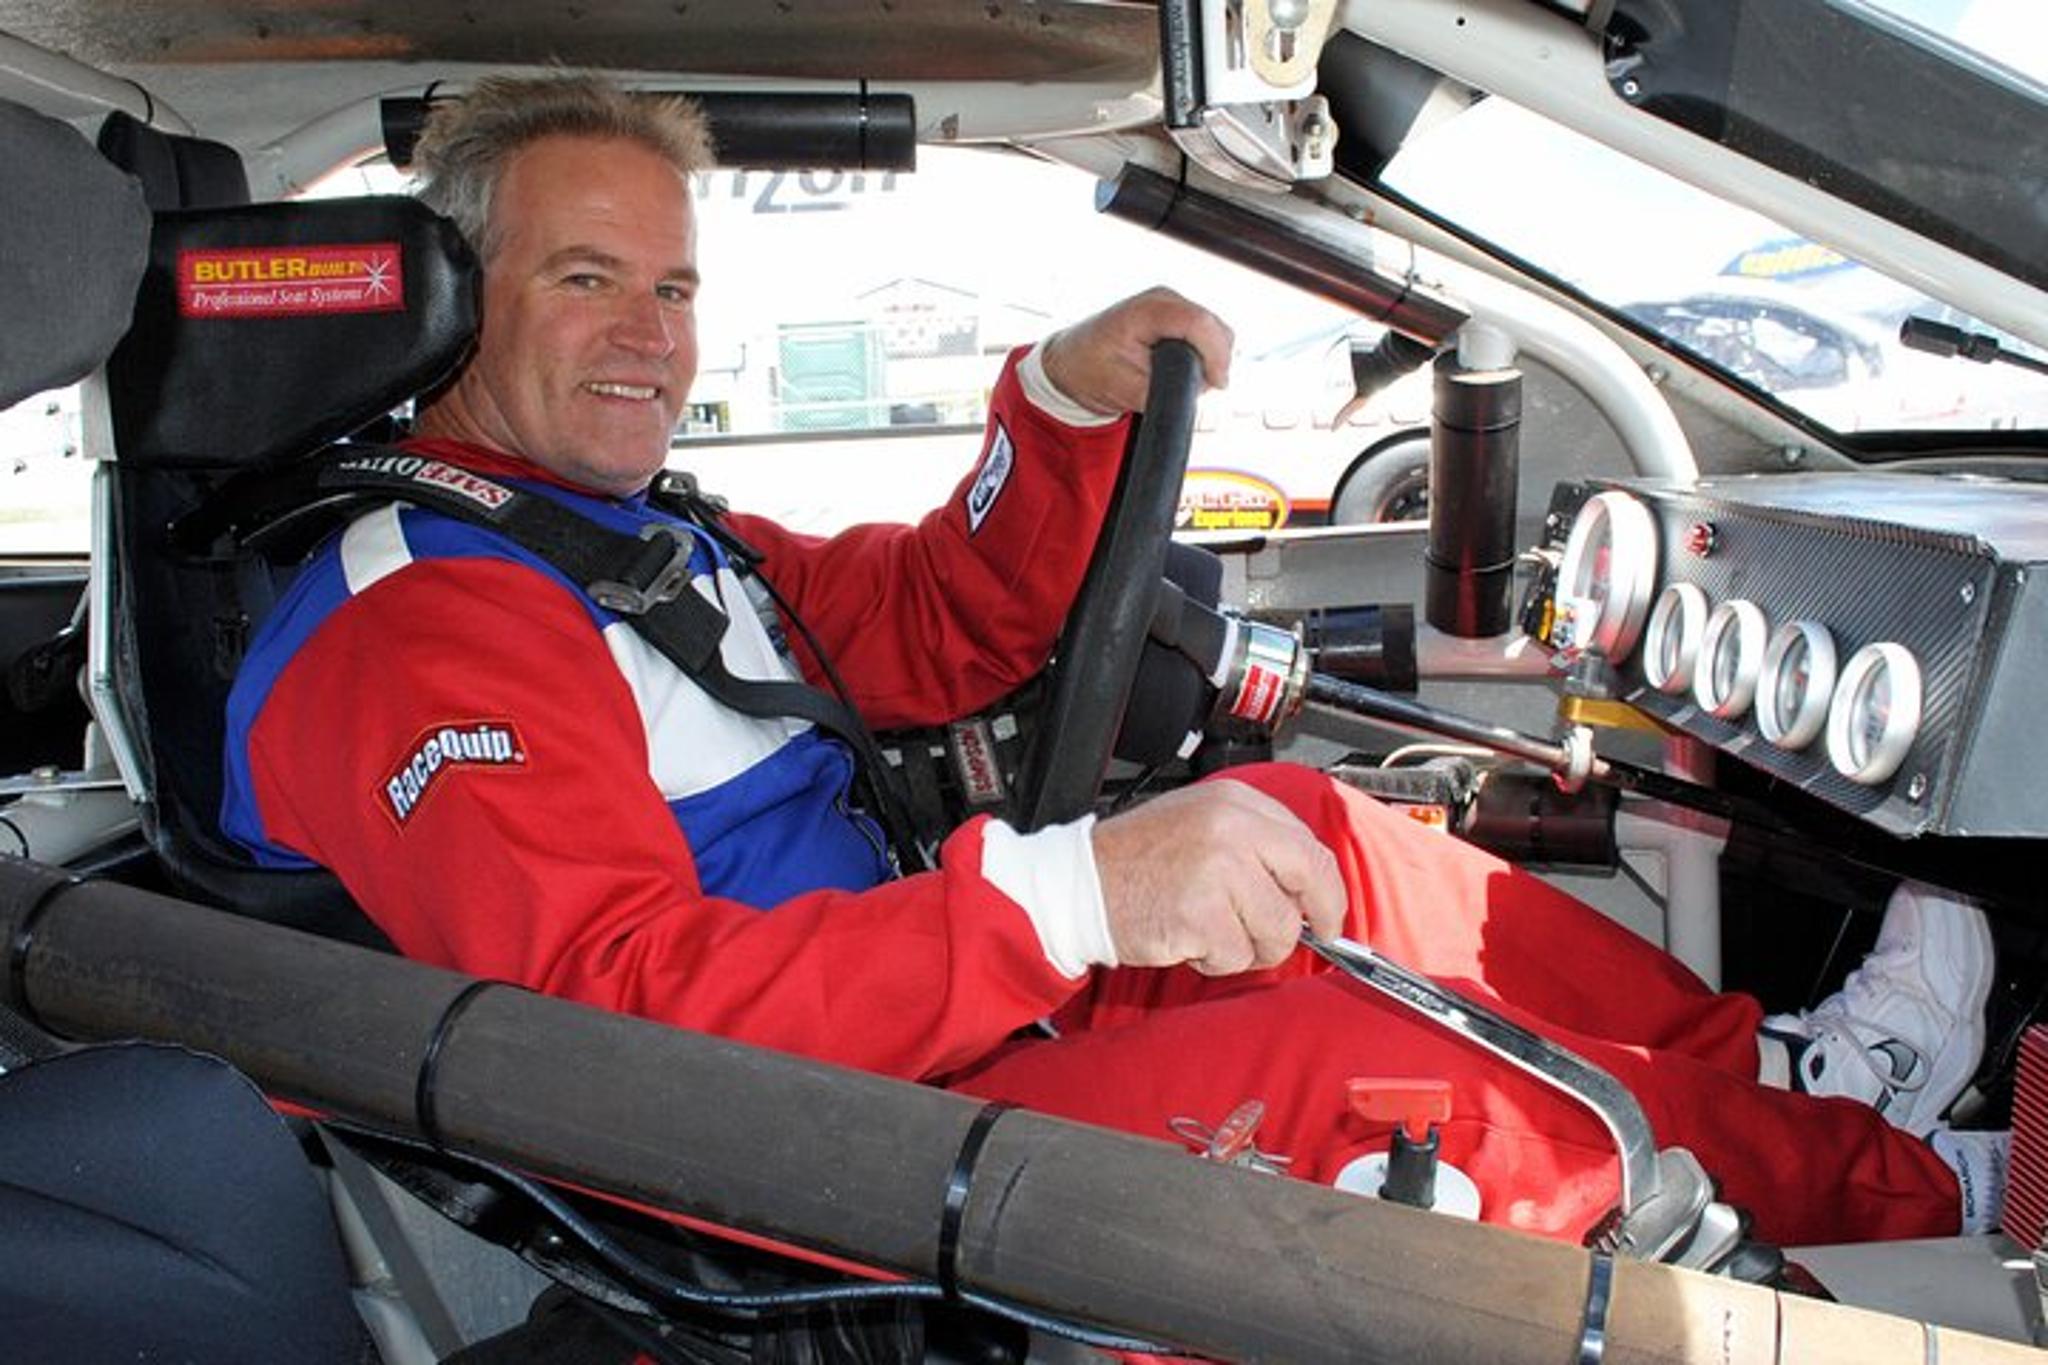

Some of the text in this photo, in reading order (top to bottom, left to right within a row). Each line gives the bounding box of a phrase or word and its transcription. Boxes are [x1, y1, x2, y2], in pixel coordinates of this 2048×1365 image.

[192, 286, 363, 311] Professional Seat Systems
